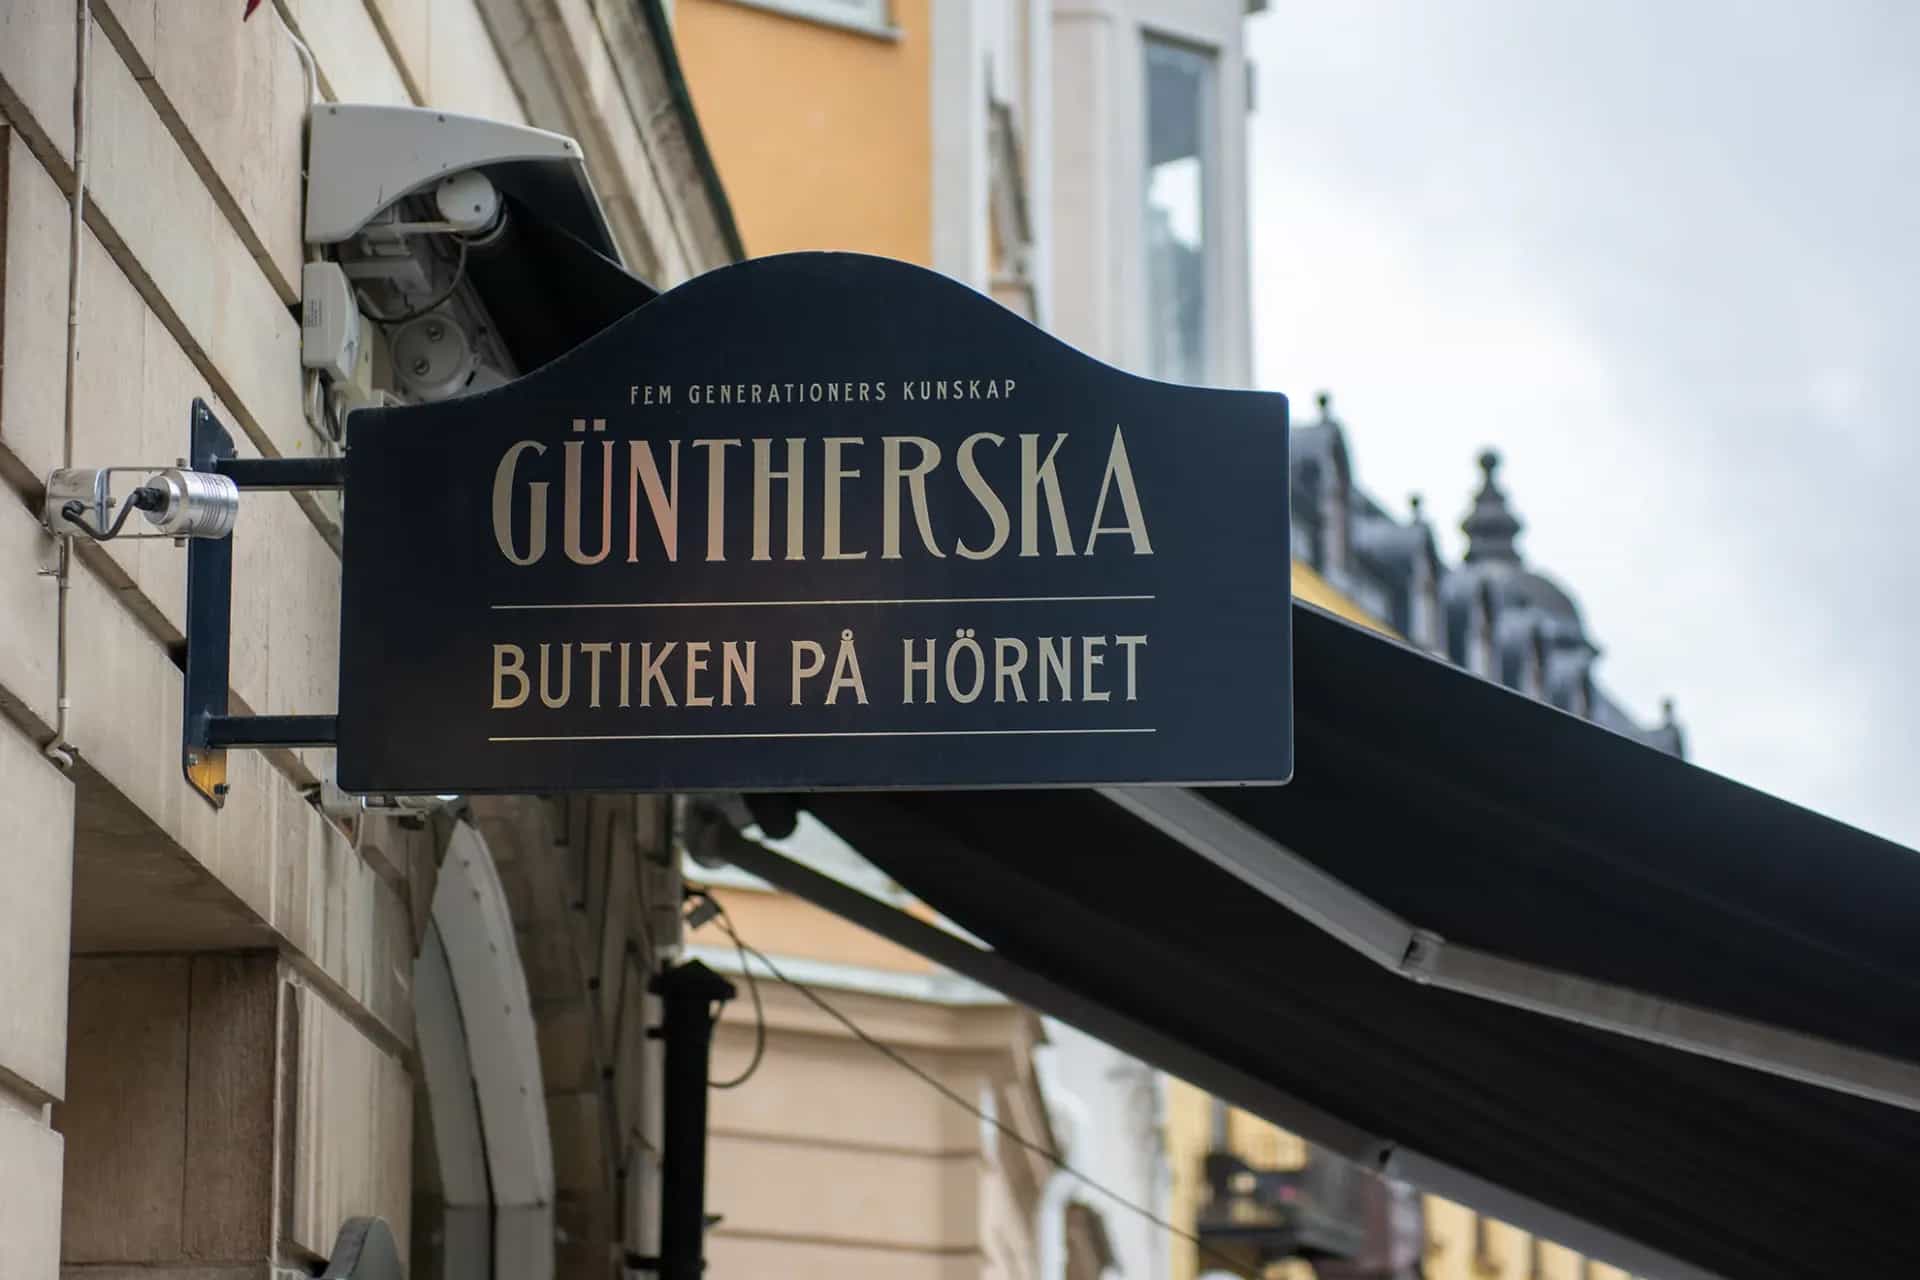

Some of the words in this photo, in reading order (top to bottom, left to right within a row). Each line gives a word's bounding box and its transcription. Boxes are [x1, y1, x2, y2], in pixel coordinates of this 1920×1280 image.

[631, 385, 672, 405] FEM
[688, 382, 887, 404] GENERATIONERS
[903, 379, 1017, 401] KUNSKAP
[493, 419, 1155, 566] GÜNTHERSKA
[491, 640, 757, 710] BUTIKEN
[790, 628, 870, 706] PÅ
[902, 628, 1148, 705] HÖRNET
